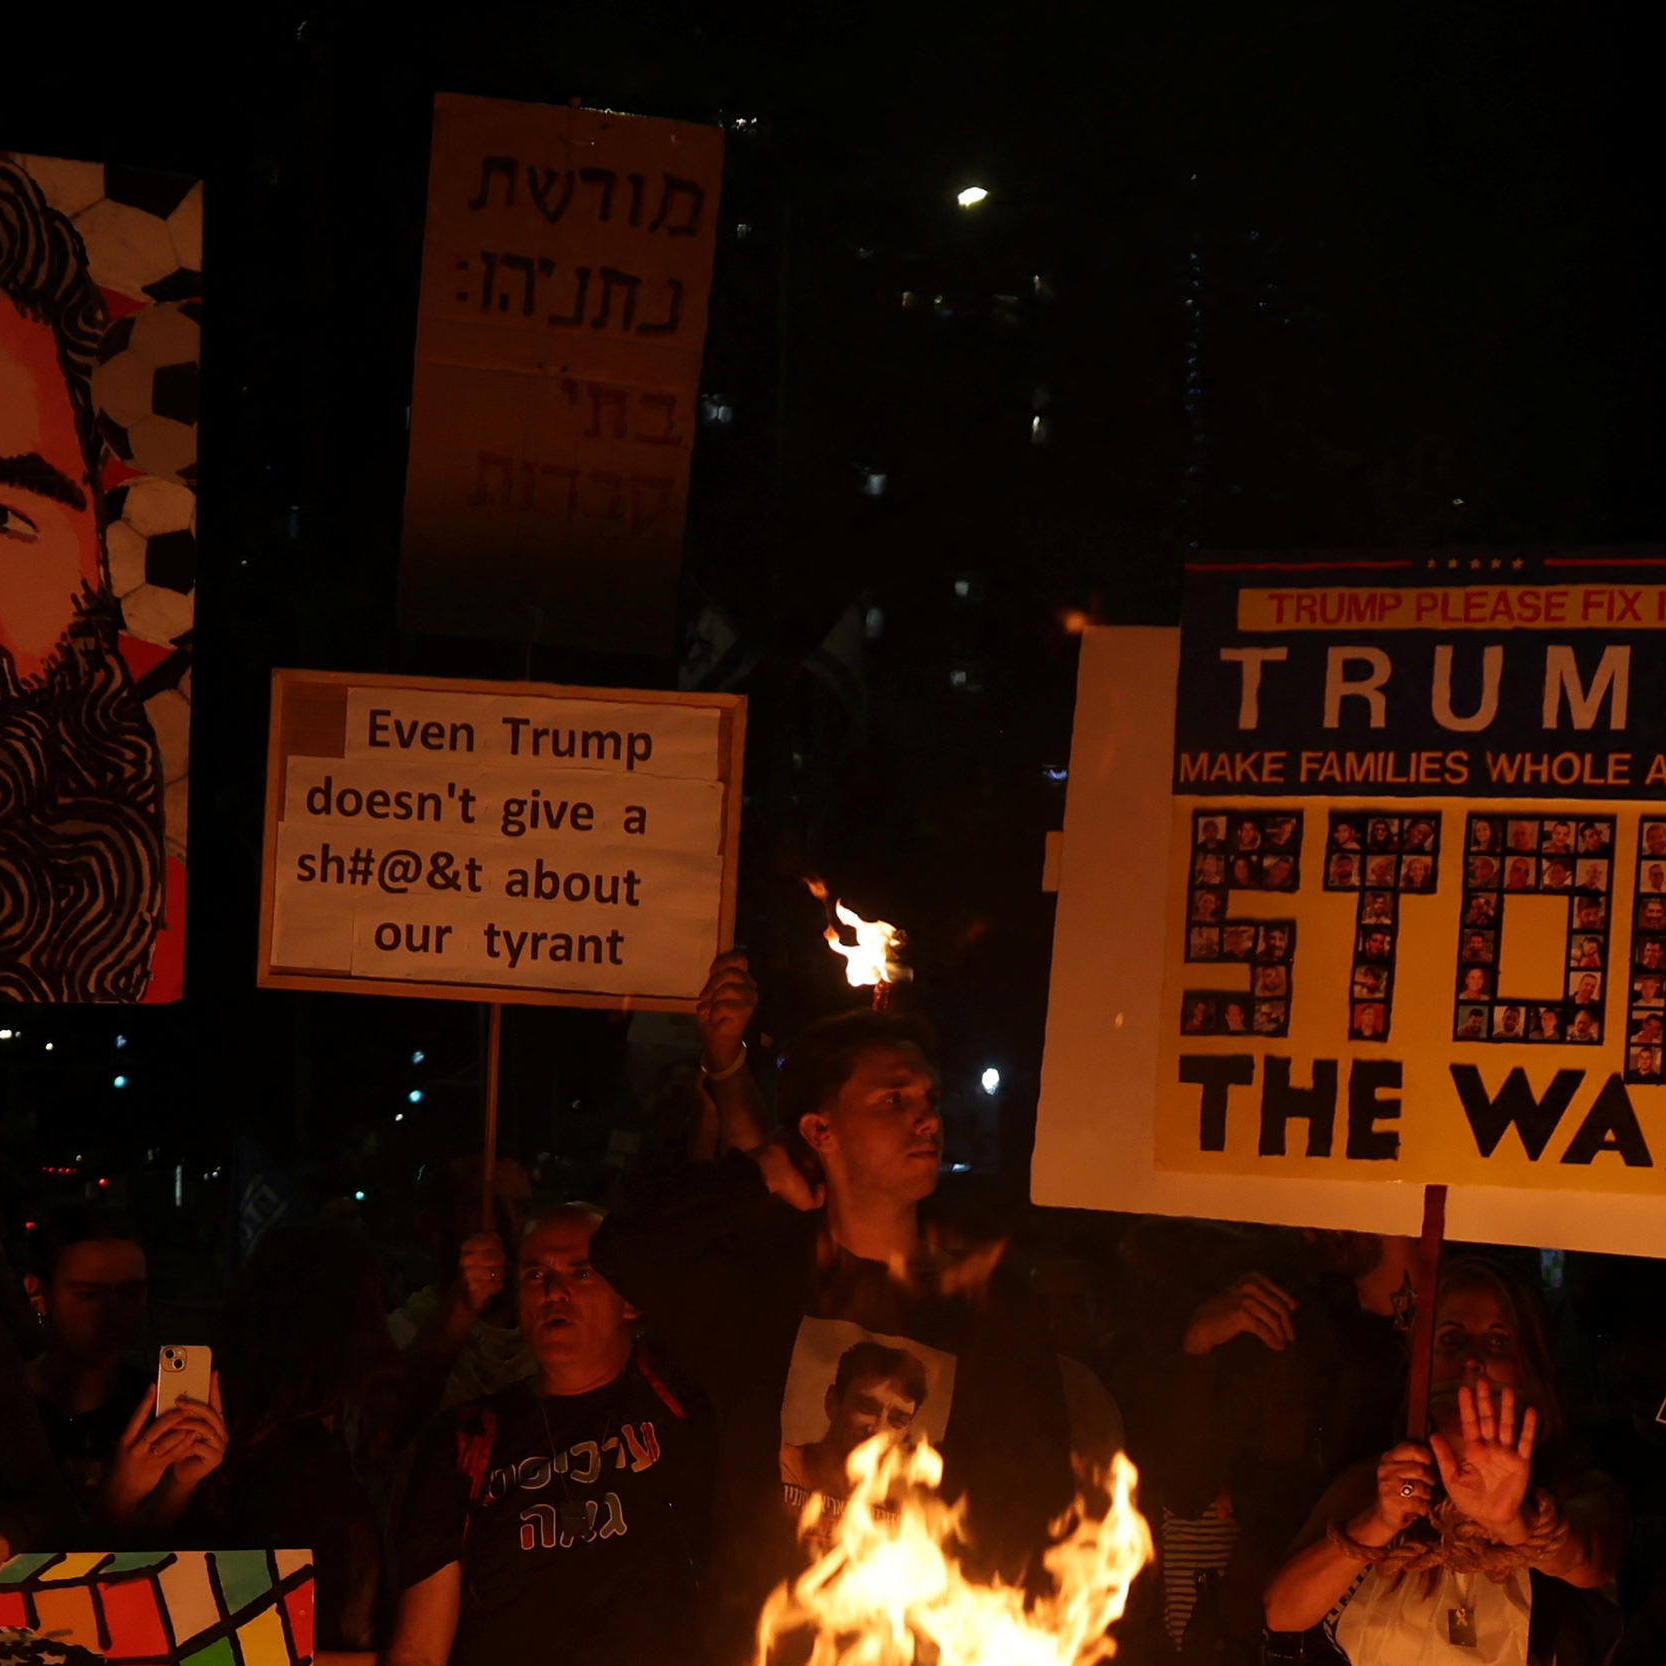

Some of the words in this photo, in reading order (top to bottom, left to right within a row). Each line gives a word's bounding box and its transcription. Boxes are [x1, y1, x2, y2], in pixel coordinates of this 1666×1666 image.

[468, 156, 704, 236] מורשת
[561, 377, 683, 446] בתי
[1269, 590, 1402, 624] TRUMP
[1416, 589, 1568, 623] PLEASE
[1582, 589, 1642, 622] FIX
[368, 709, 474, 752] Even
[503, 717, 652, 769] Trump
[1179, 751, 1287, 784] MAKE
[1299, 750, 1469, 784] FAMILIES
[1484, 751, 1632, 787] WHOLE
[306, 776, 476, 823] doesn't
[502, 790, 594, 836] give
[623, 805, 646, 834] a
[297, 844, 482, 893] sh#@&t
[506, 860, 640, 906] about
[375, 922, 452, 954] our
[485, 924, 624, 967] tyrant
[1179, 1055, 1403, 1162] THE
